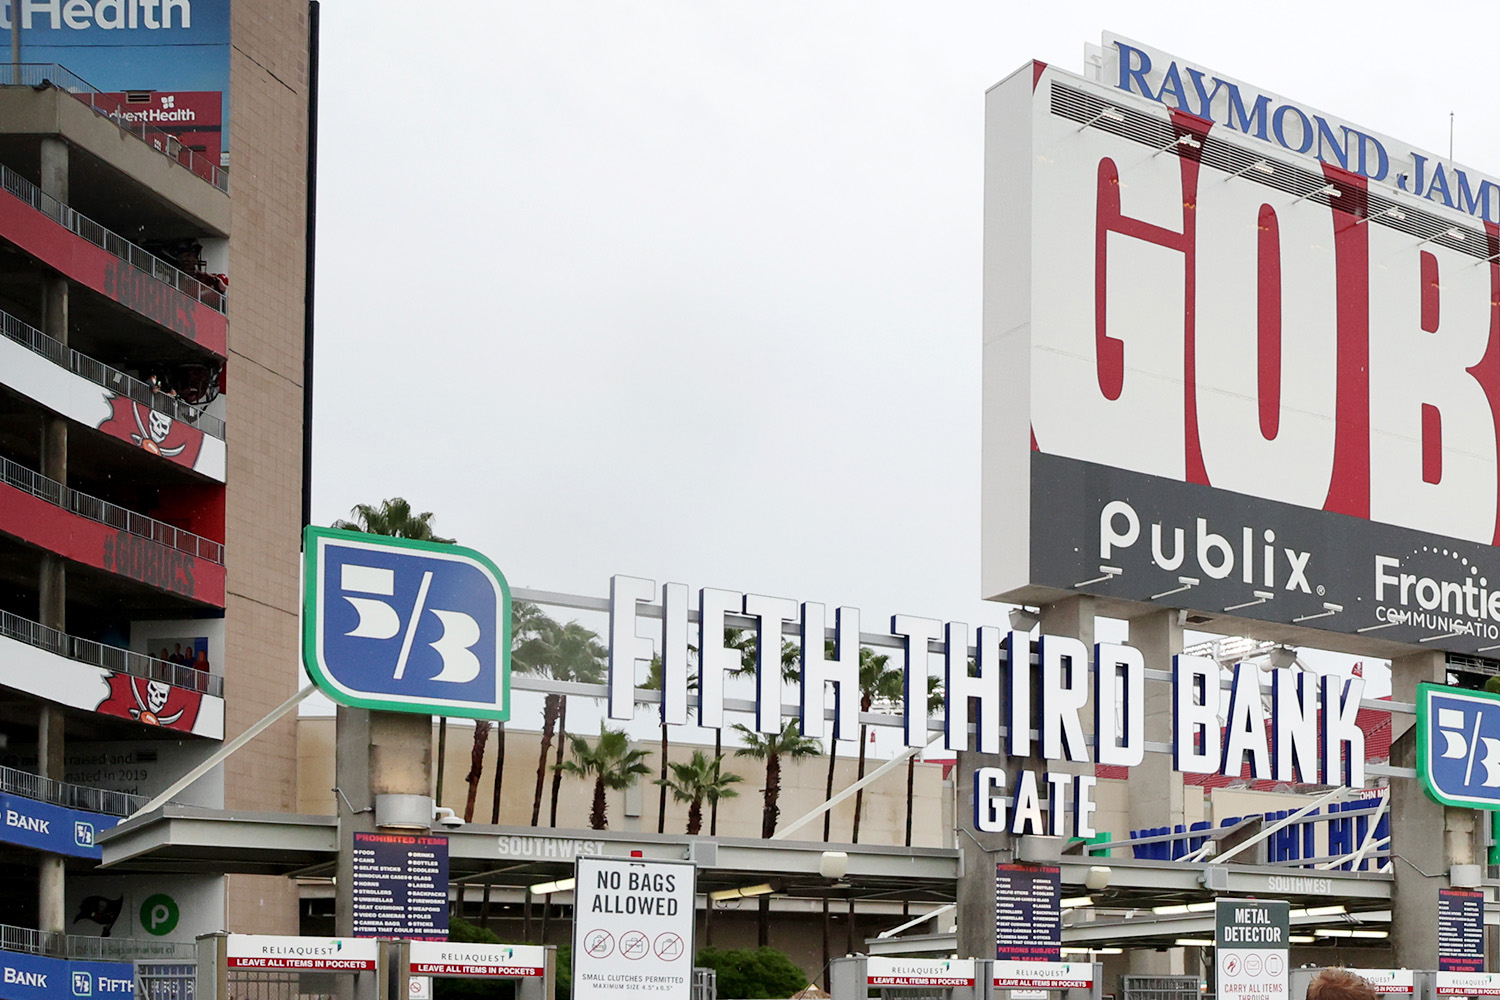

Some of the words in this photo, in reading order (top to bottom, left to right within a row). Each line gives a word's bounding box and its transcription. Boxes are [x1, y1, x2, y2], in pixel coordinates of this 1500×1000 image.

[1112, 40, 1389, 181] RAYMOND
[1031, 75, 1338, 512] GO
[1100, 501, 1312, 594] Publix
[608, 574, 861, 741] FIFTH
[891, 613, 1145, 767] THIRD
[1172, 653, 1367, 789] BANK
[119, 769, 148, 781] 2019
[974, 766, 1097, 839] GATE
[6, 809, 50, 835] BANK
[356, 833, 416, 845] PROHIBITED
[417, 836, 447, 846] ITEMS
[498, 836, 605, 857] SOUTHWEST
[597, 870, 621, 890] NO
[628, 872, 676, 893] BAGS
[1269, 877, 1332, 893] SOUTHWEST
[591, 894, 678, 916] ALLOWED
[1235, 908, 1271, 924] METAL
[1224, 926, 1282, 943] DETECTOR
[262, 946, 334, 956] RELIAQUEST
[441, 952, 506, 962] RELIAQUEST
[236, 958, 266, 968] LEAVE
[267, 959, 285, 968] ALL
[286, 959, 313, 968] ITEMS
[314, 960, 324, 968] IN
[325, 960, 367, 969] POCKETS
[418, 964, 445, 973] LEAVE
[446, 965, 462, 973] ALL
[462, 966, 488, 974] ITEMS
[488, 966, 498, 975] IN
[498, 967, 536, 976] POCKETS
[891, 966, 944, 975] RELIAQUEST
[4, 967, 48, 988] BANK
[582, 973, 605, 981] SMALL
[607, 974, 643, 983] CLUTCHES
[645, 975, 684, 984] PERMITTED
[1015, 969, 1065, 977] RELIAQUEST
[894, 977, 908, 985] ALL
[937, 978, 968, 986] POCKETS
[1058, 980, 1087, 988] POCKETS
[1224, 983, 1247, 993] CARRY
[1248, 983, 1261, 993] ALL
[1262, 983, 1283, 993] ITEMS
[1452, 978, 1488, 986] RELIAQUEST
